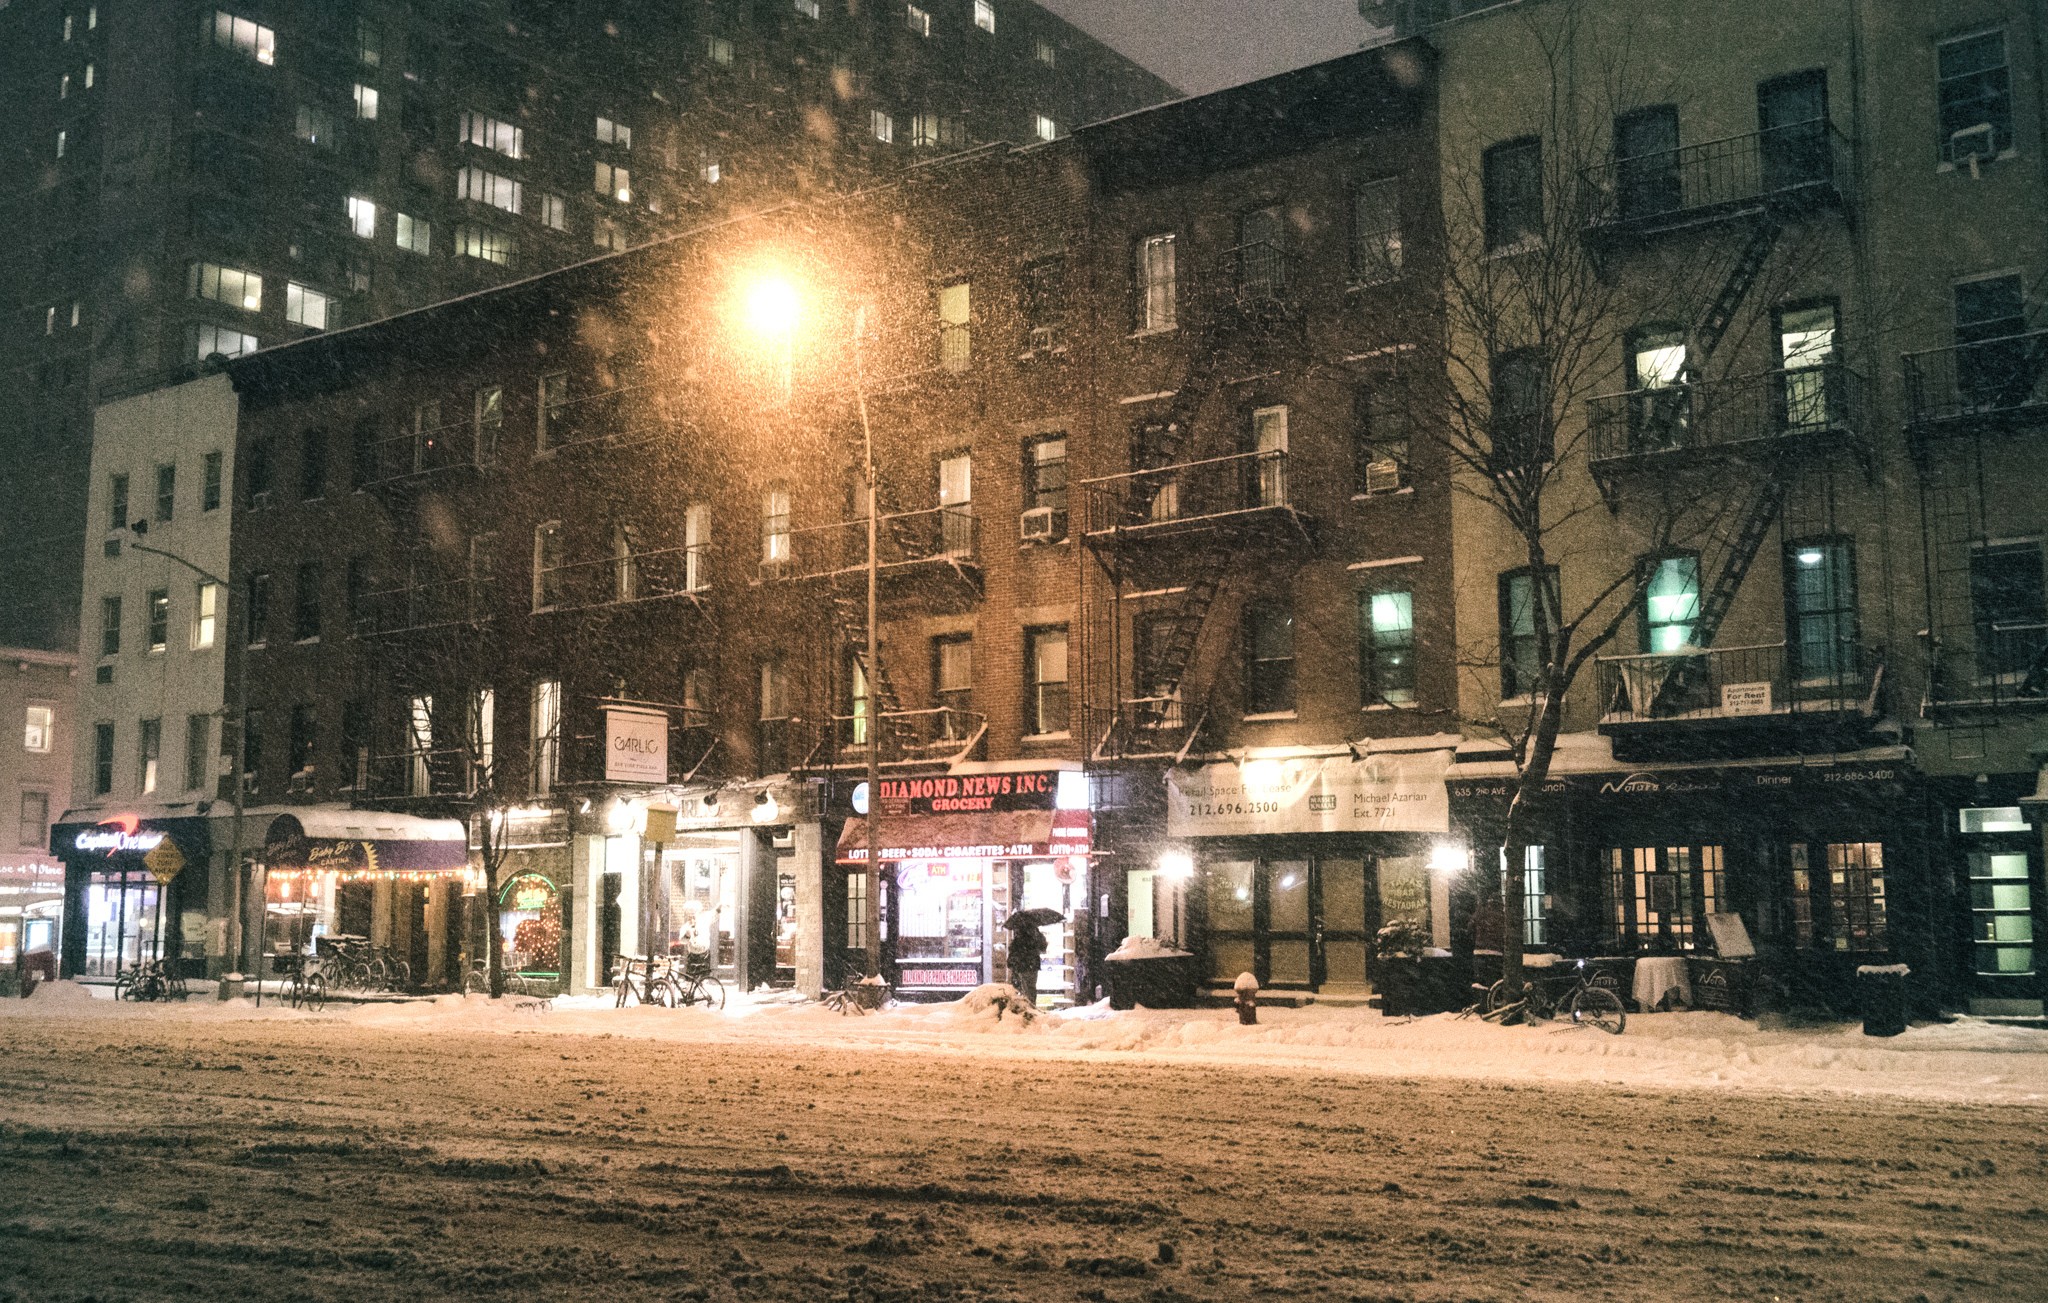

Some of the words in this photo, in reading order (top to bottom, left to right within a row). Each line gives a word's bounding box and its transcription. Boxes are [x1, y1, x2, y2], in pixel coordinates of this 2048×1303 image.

[614, 736, 659, 755] GARLIC
[1757, 774, 1792, 785] Dinner
[1824, 769, 1895, 782] 212-686-3400
[880, 777, 958, 799] DIAMOND
[962, 775, 1011, 796] NEWS
[1016, 774, 1053, 794] INC.
[1209, 784, 1238, 798] Space
[1455, 787, 1471, 797] 635
[1541, 782, 1566, 792] unch
[932, 796, 995, 812] GROCERY
[1353, 792, 1390, 804] Michael
[1392, 792, 1427, 803] Azarian
[1189, 801, 1279, 816] 212.696.2500
[1353, 808, 1372, 818] Ext.
[1375, 807, 1396, 818] 7721
[75, 831, 119, 851] Capital
[117, 831, 139, 850] One
[308, 846, 334, 862] Baby
[882, 848, 906, 858] BEER
[911, 847, 938, 857] SODA
[943, 845, 1004, 857] CIGARETTES
[1010, 843, 1033, 855] ATM
[1049, 845, 1070, 854] LOTTO
[1074, 844, 1090, 853] ATM
[29, 863, 63, 875] Wine
[931, 867, 947, 875] ATM
[932, 969, 949, 985] PHONE
[949, 969, 977, 985] CHARGERS
